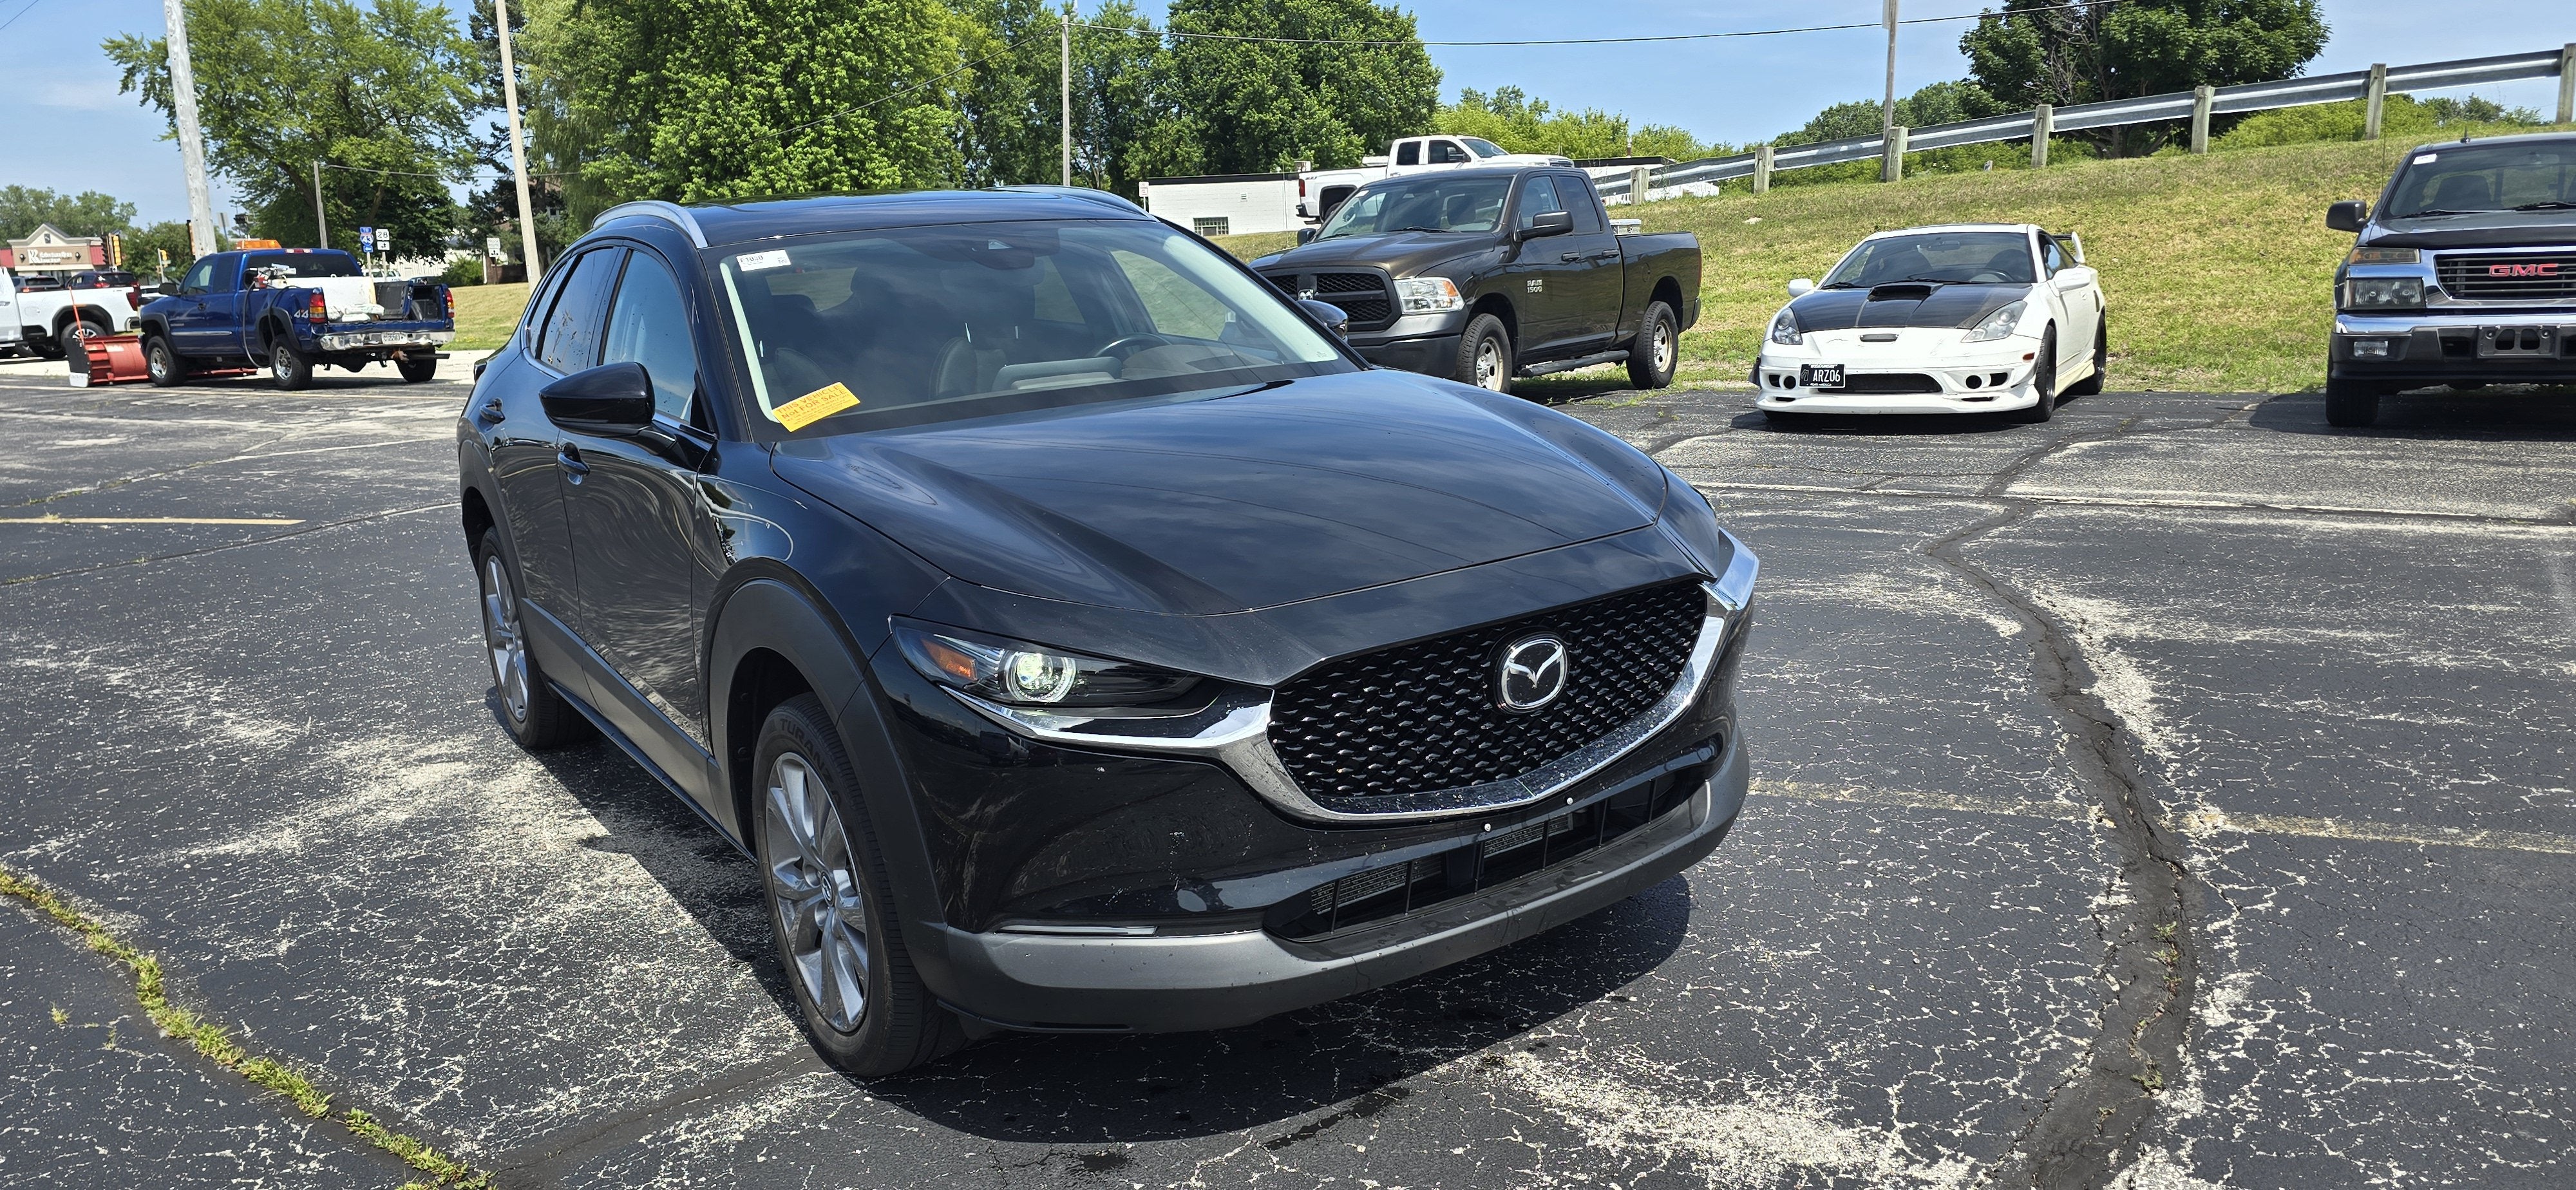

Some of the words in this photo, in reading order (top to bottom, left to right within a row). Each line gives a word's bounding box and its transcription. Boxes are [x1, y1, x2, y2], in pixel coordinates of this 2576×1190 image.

[2489, 263, 2559, 277] GMC
[1812, 369, 1841, 382] ARZ06
[777, 402, 799, 413] THIS
[800, 384, 841, 404] VEHICLE
[799, 399, 821, 411] FOR
[821, 388, 847, 401] SALE
